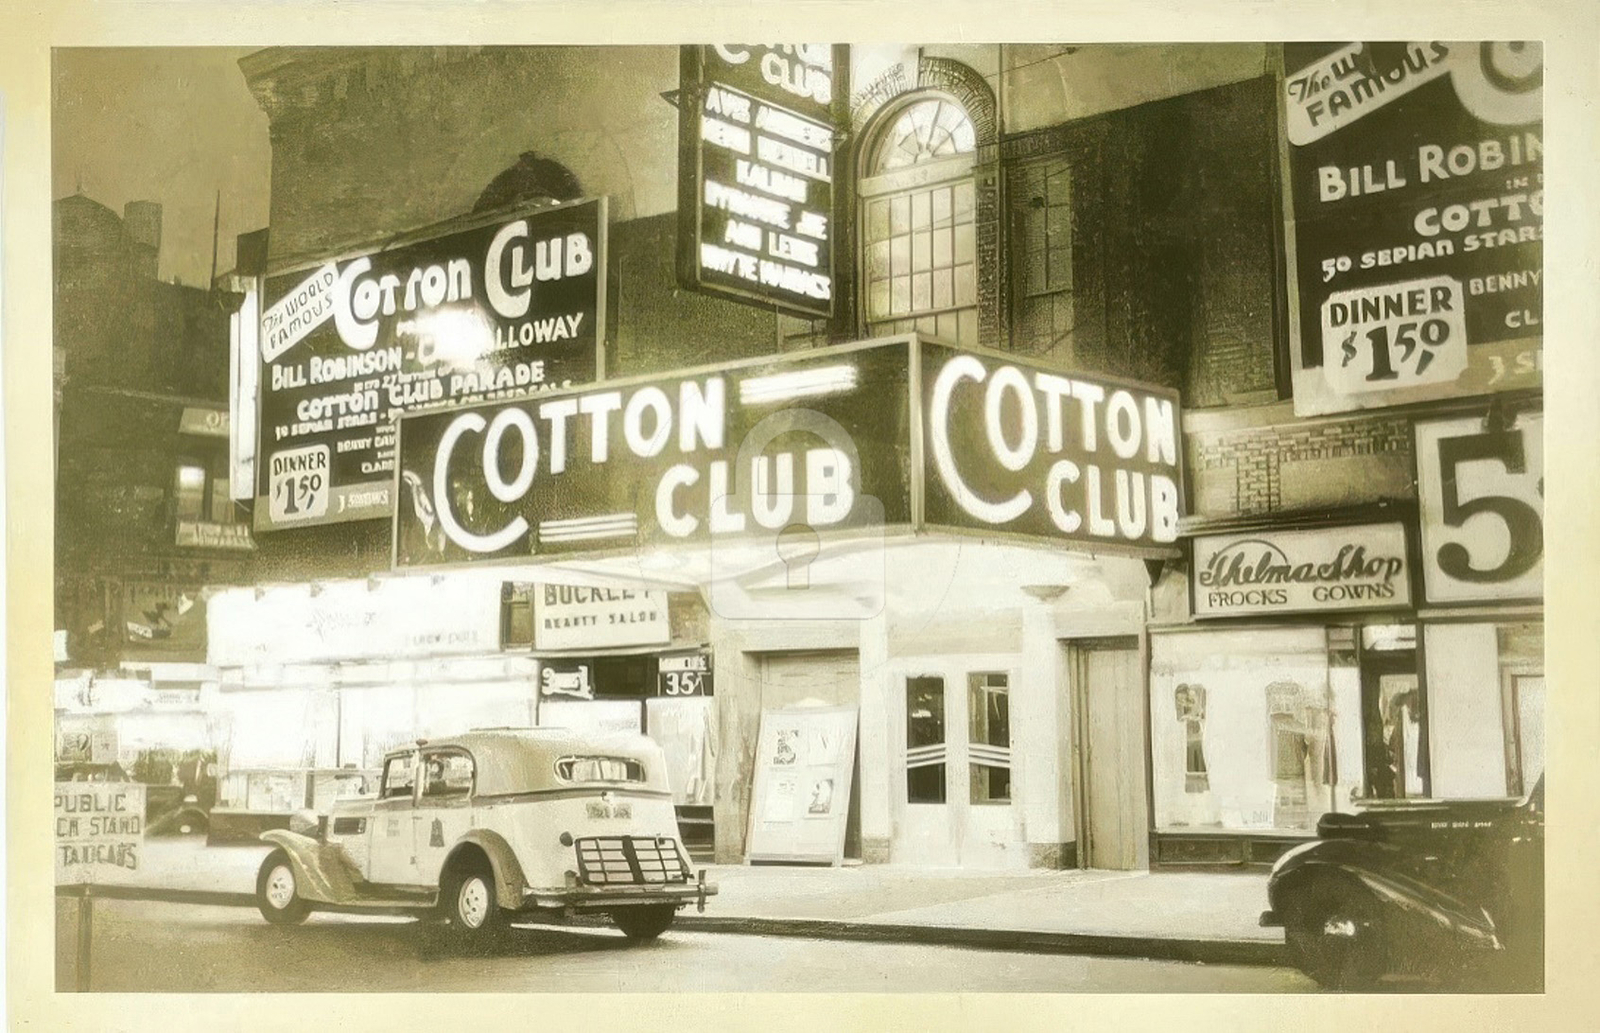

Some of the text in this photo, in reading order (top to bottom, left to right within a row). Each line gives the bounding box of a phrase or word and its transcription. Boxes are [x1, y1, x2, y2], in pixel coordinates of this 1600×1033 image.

[1287, 71, 1330, 104] The
[1306, 41, 1449, 126] FAMOUS
[1318, 133, 1543, 202] BILL ROBIN
[1414, 192, 1543, 236] COTTO
[333, 256, 473, 350] COTTON
[484, 220, 592, 318] CLUB
[1321, 256, 1351, 282] 50
[1360, 239, 1454, 269] SEPIAN
[1469, 269, 1542, 295] BENNY
[270, 292, 334, 349] FAMOUS
[1330, 286, 1454, 327] DINNER
[272, 364, 306, 391] BILL
[310, 347, 402, 385] ROBINSON
[297, 390, 378, 421] COTTON
[389, 378, 443, 406] CLUB
[451, 360, 545, 396] PARADE
[273, 451, 326, 476] DINNER
[434, 377, 725, 552] COTTON
[931, 355, 1176, 524] COTTON
[655, 448, 855, 537] CLUB
[1047, 459, 1180, 543] CLUB
[1208, 582, 1395, 608] FROCKS GOWNS
[54, 793, 127, 813] PUBLIC
